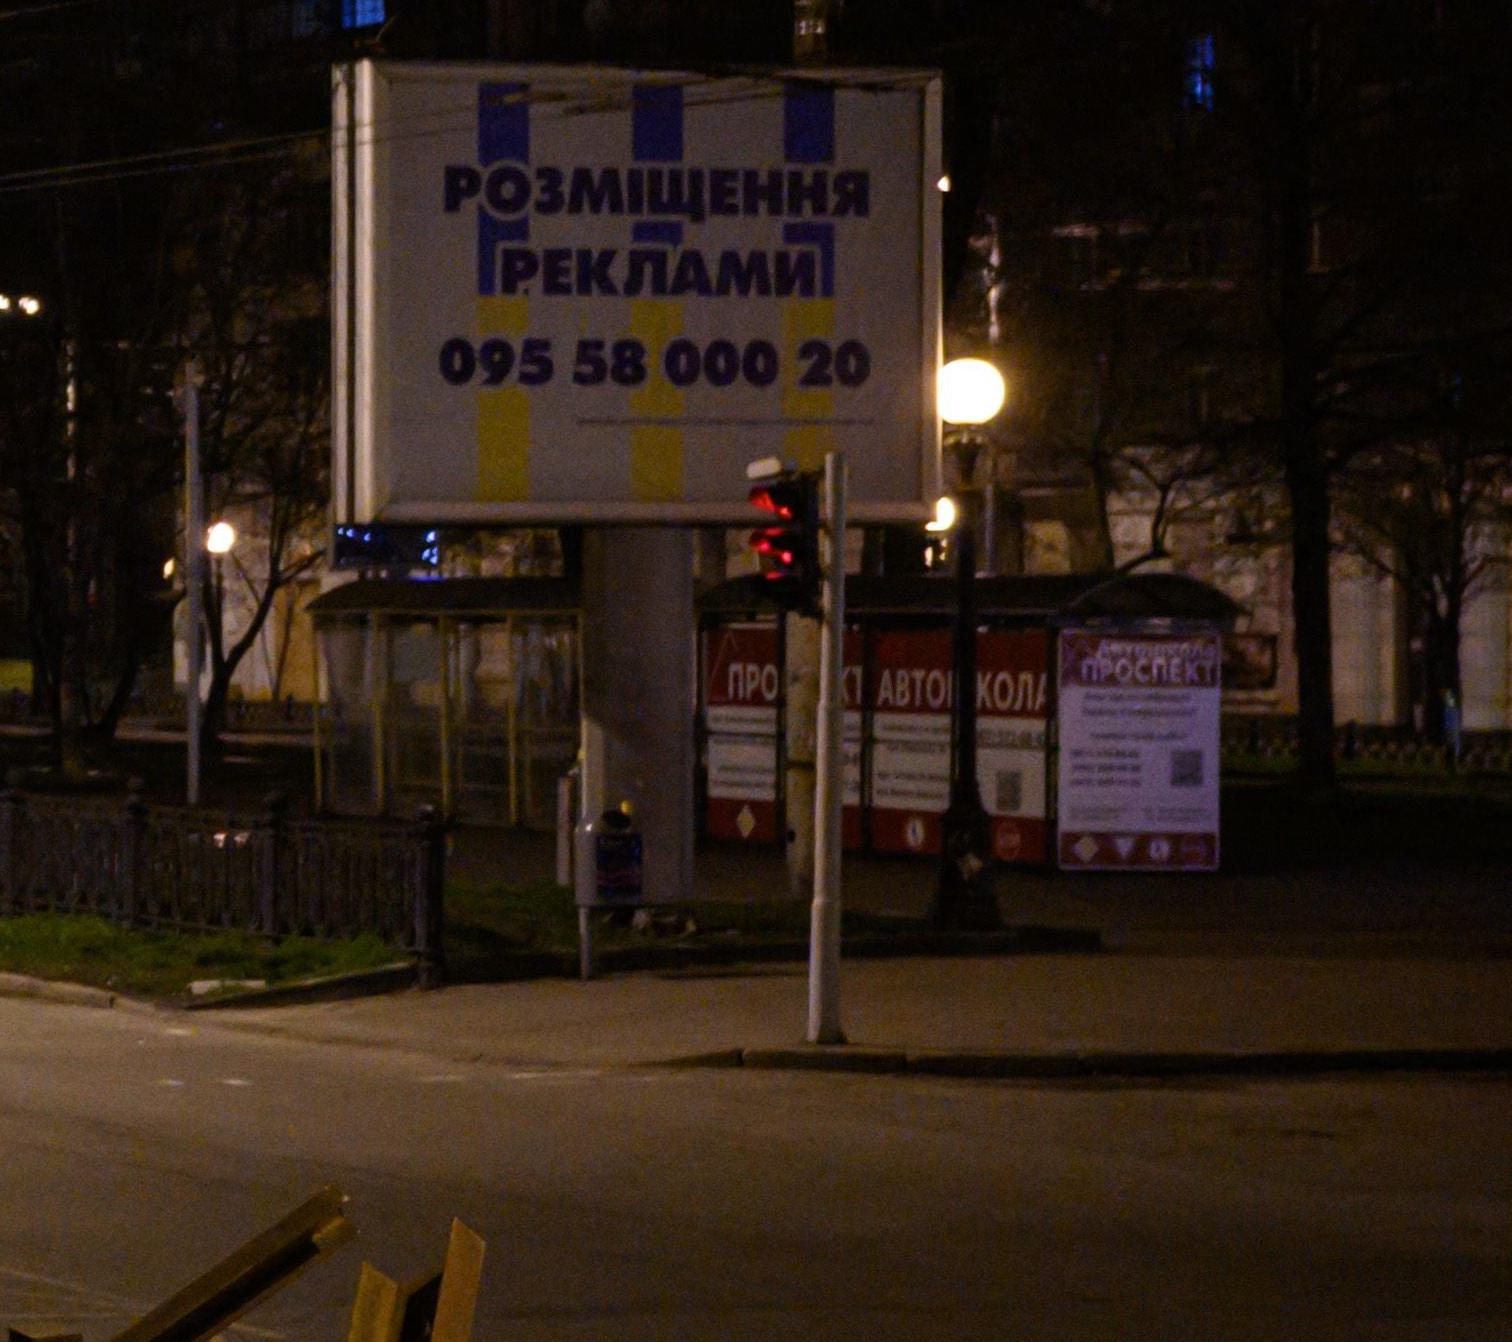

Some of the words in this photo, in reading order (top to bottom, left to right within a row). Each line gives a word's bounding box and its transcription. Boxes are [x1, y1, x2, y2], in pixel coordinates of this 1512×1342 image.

[443, 165, 870, 224] РОЗМІЩЕННЯ
[500, 248, 818, 297] РЕКЛАМИ
[439, 338, 553, 388] 095
[574, 338, 647, 387] 58
[664, 338, 779, 387] 000
[798, 339, 871, 388] 20
[1081, 657, 1213, 684] ПРОСПЕКТ
